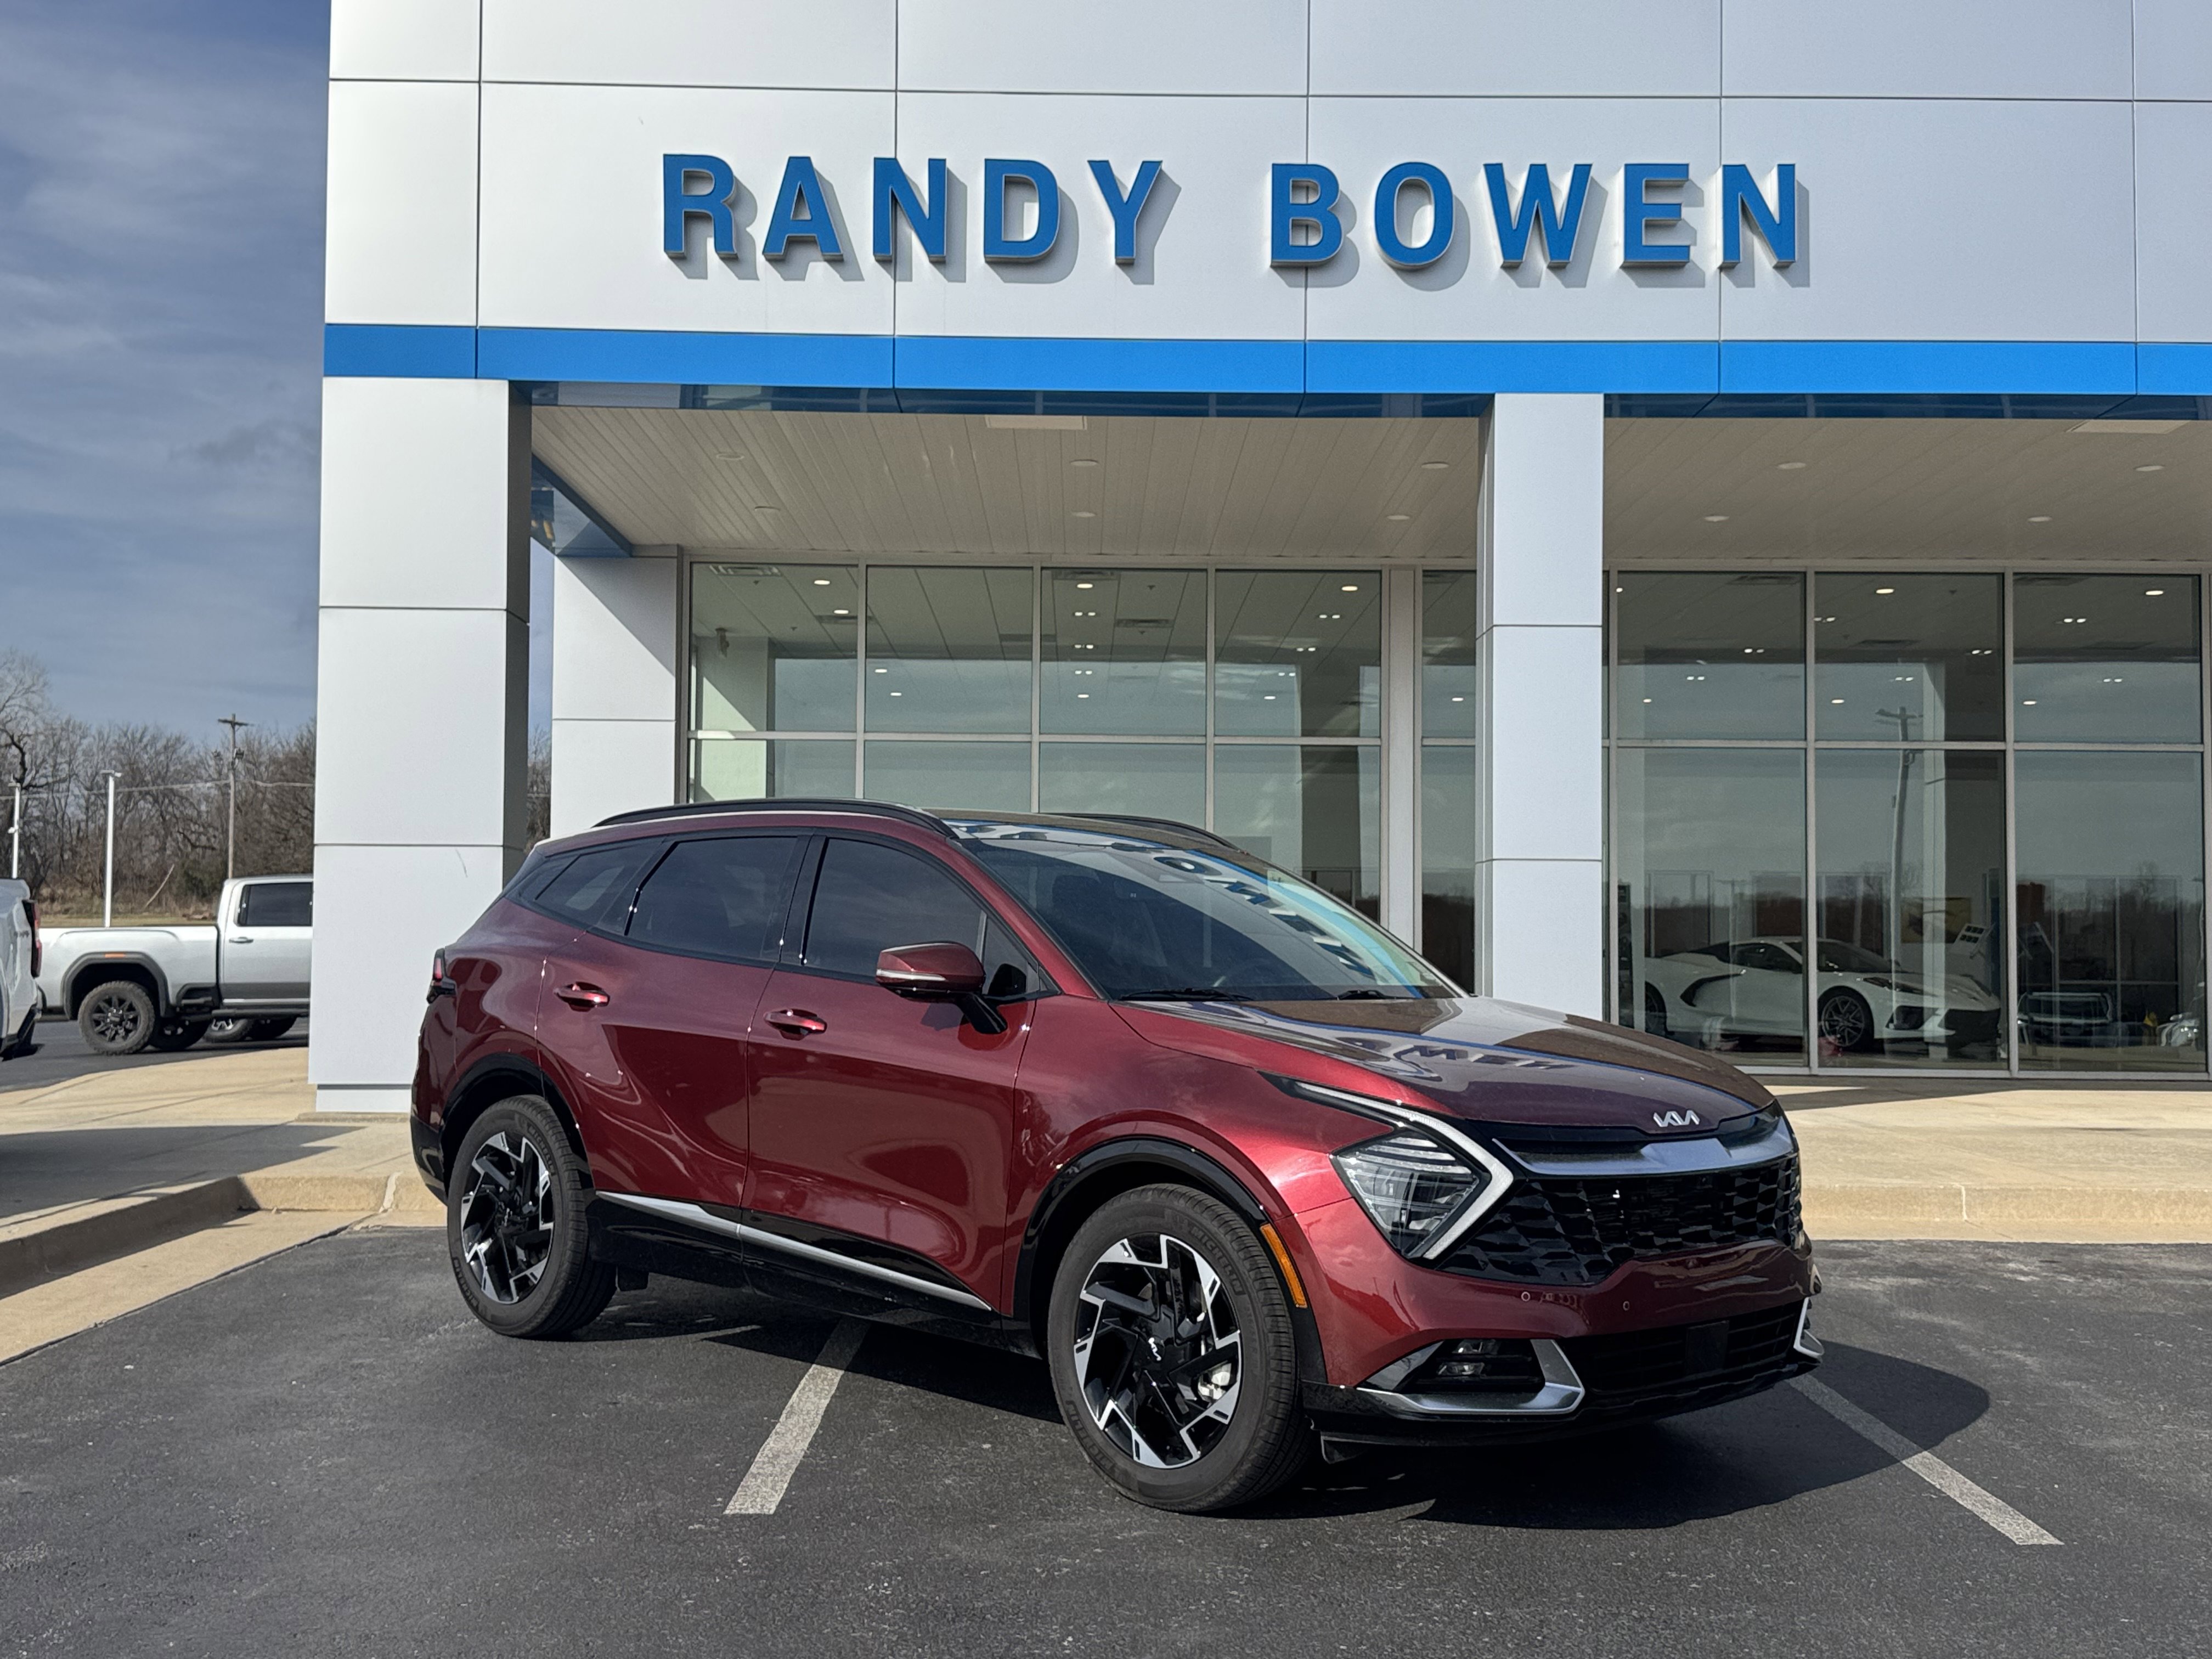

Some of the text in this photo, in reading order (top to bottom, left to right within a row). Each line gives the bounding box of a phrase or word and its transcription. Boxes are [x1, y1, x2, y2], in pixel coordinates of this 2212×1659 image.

[662, 154, 1796, 269] RANDY BOWEN
[1654, 1110, 1700, 1127] KIA
[1190, 1226, 1245, 1294] MICHELIN
